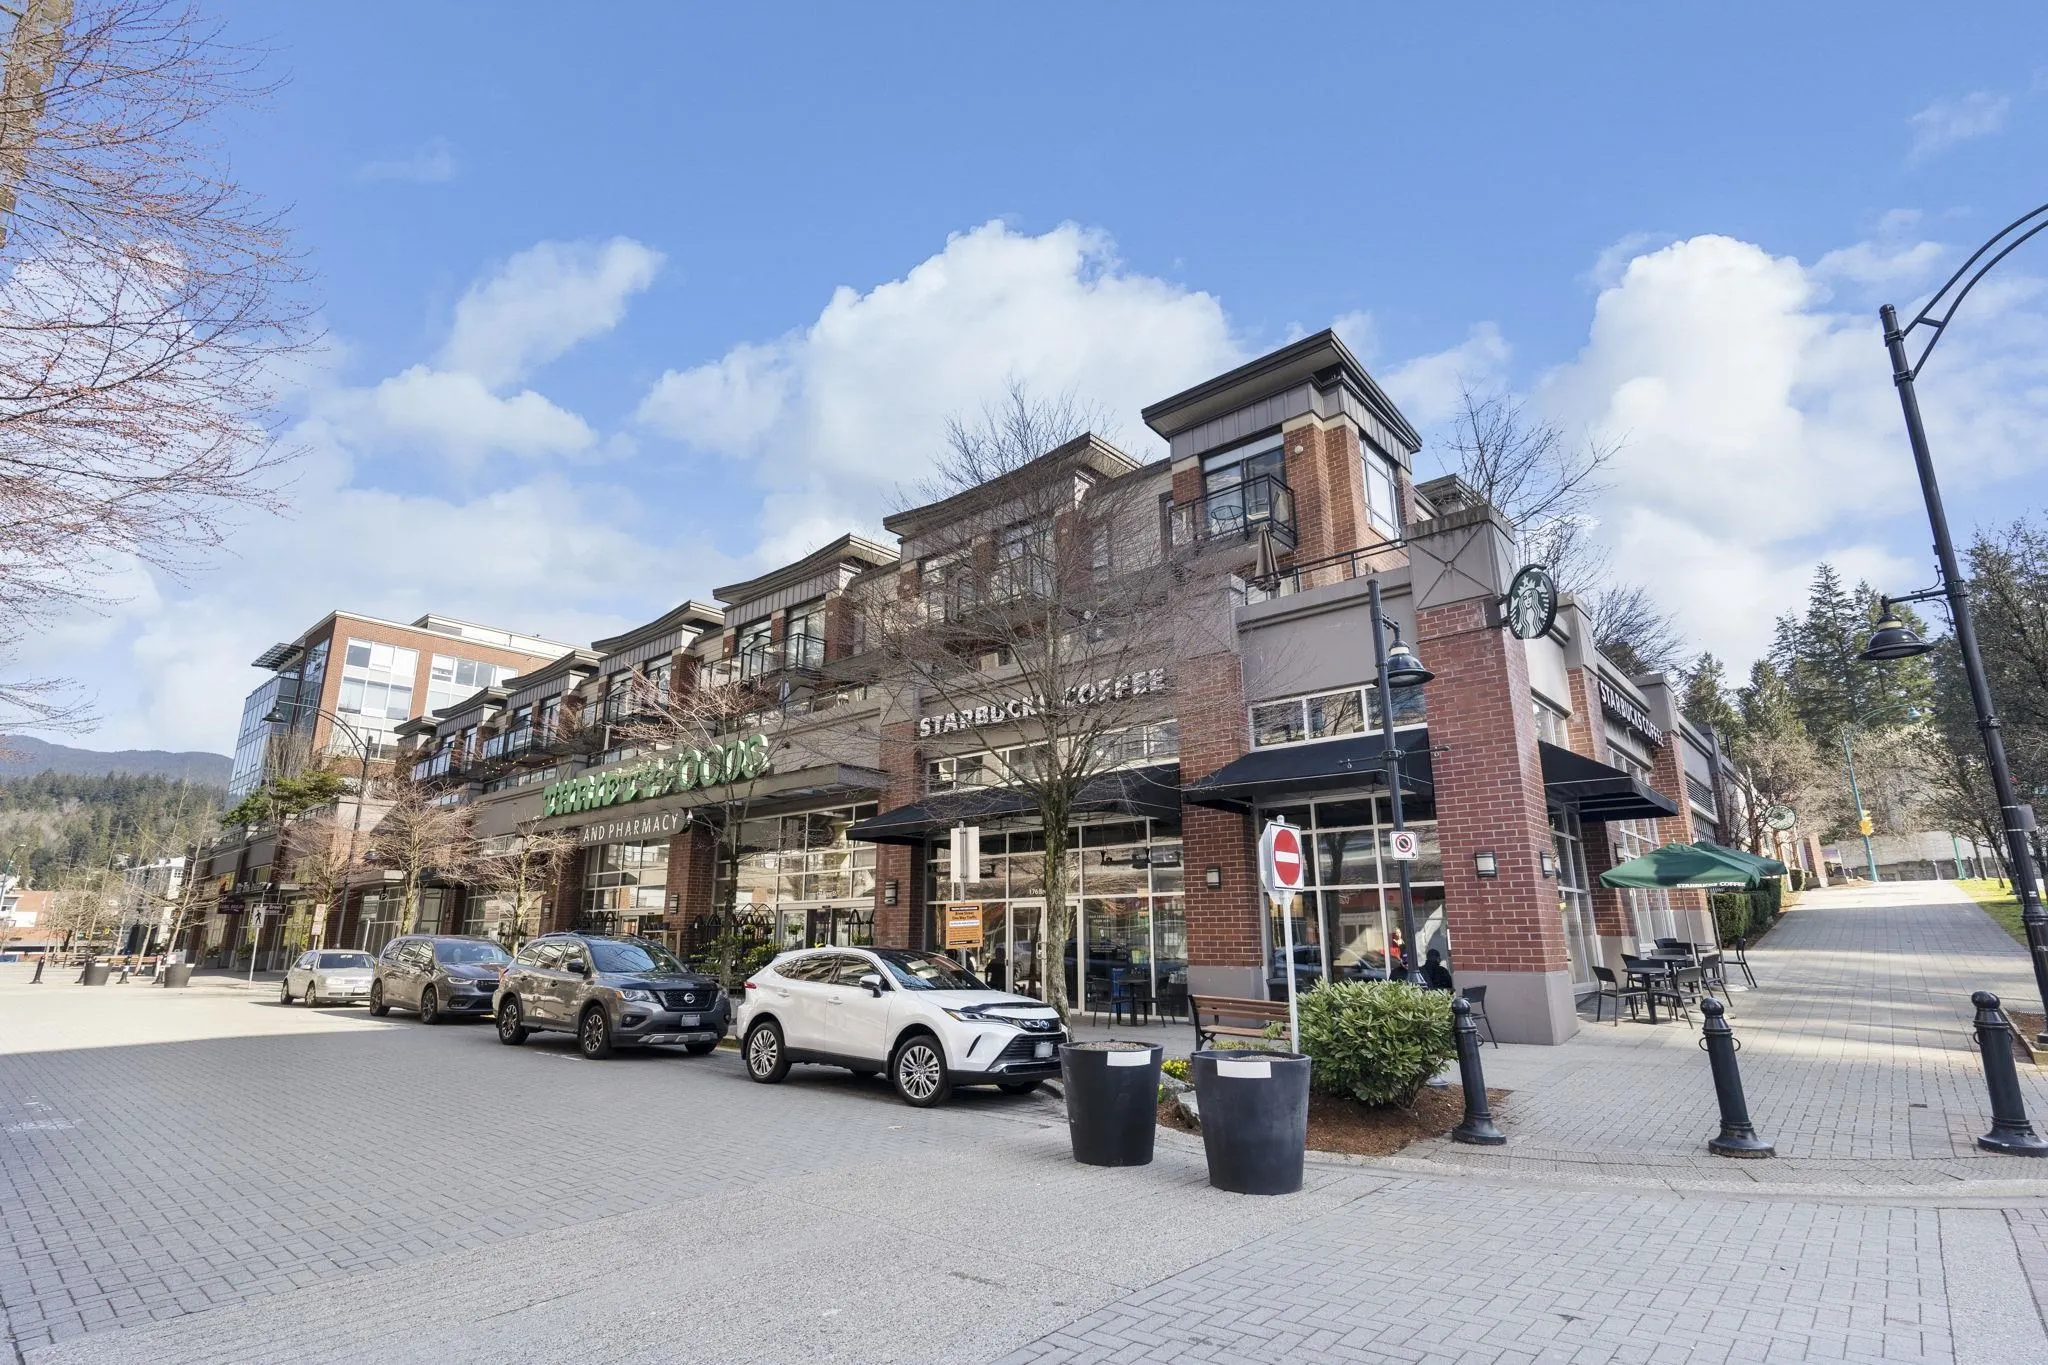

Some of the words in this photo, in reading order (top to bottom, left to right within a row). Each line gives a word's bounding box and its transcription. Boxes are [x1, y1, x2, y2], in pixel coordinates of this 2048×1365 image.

[1062, 668, 1165, 707] COFFEE
[1599, 680, 1643, 731] STARBUCKS
[1642, 716, 1664, 747] COFFEE
[583, 825, 605, 842] AND
[608, 813, 679, 839] PHARMACY
